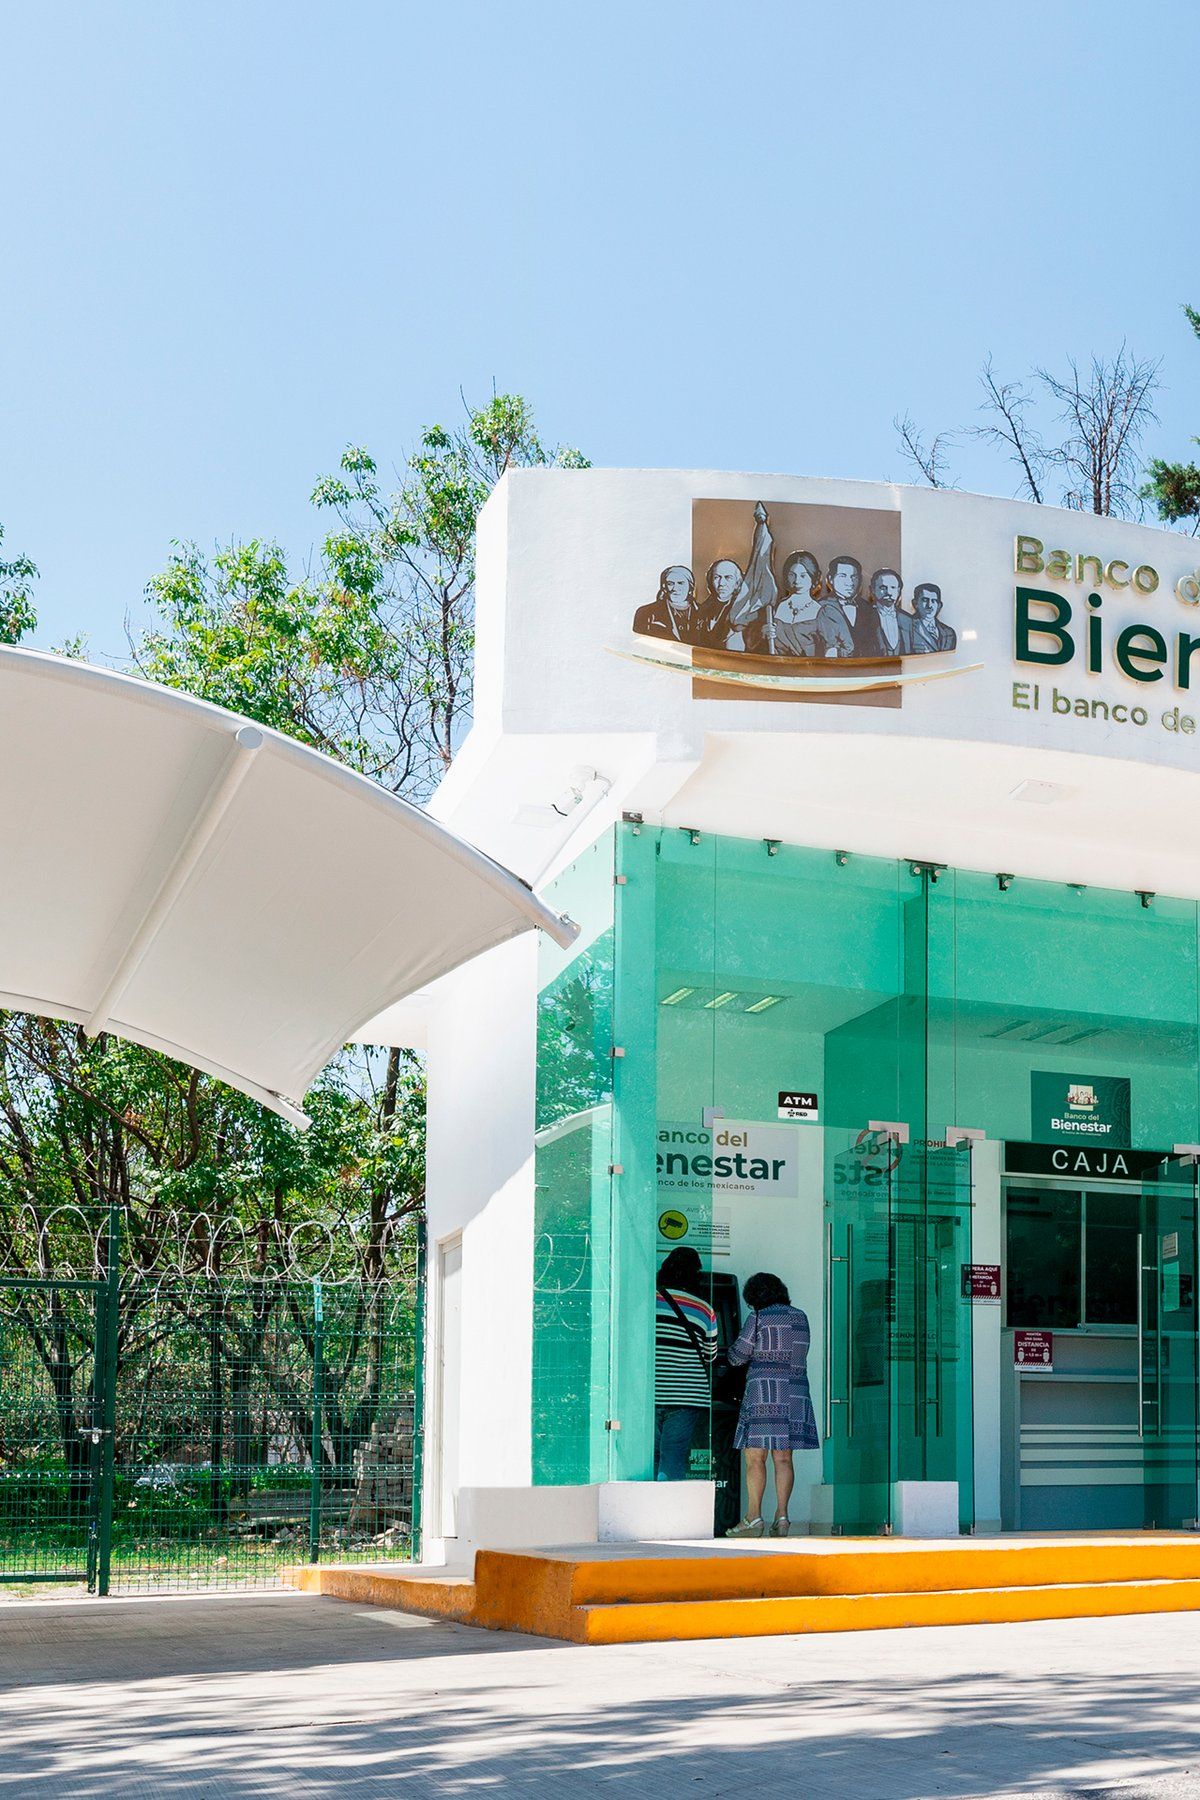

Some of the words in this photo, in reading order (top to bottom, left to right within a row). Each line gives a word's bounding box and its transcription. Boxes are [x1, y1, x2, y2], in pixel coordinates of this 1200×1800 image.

[1014, 534, 1160, 595] Banco
[1012, 682, 1039, 711] El
[1052, 687, 1148, 726] banco
[1161, 706, 1197, 735] de
[783, 1096, 812, 1106] ATM
[1064, 1112, 1086, 1120] Banco
[1051, 1118, 1112, 1133] Bienestar
[656, 1130, 710, 1145] anco
[716, 1131, 748, 1147] del
[1052, 1149, 1129, 1175] CAJA
[1161, 1156, 1169, 1175] 1
[677, 1179, 689, 1188] de
[691, 1180, 705, 1188] los
[707, 1182, 755, 1191] mexicanos
